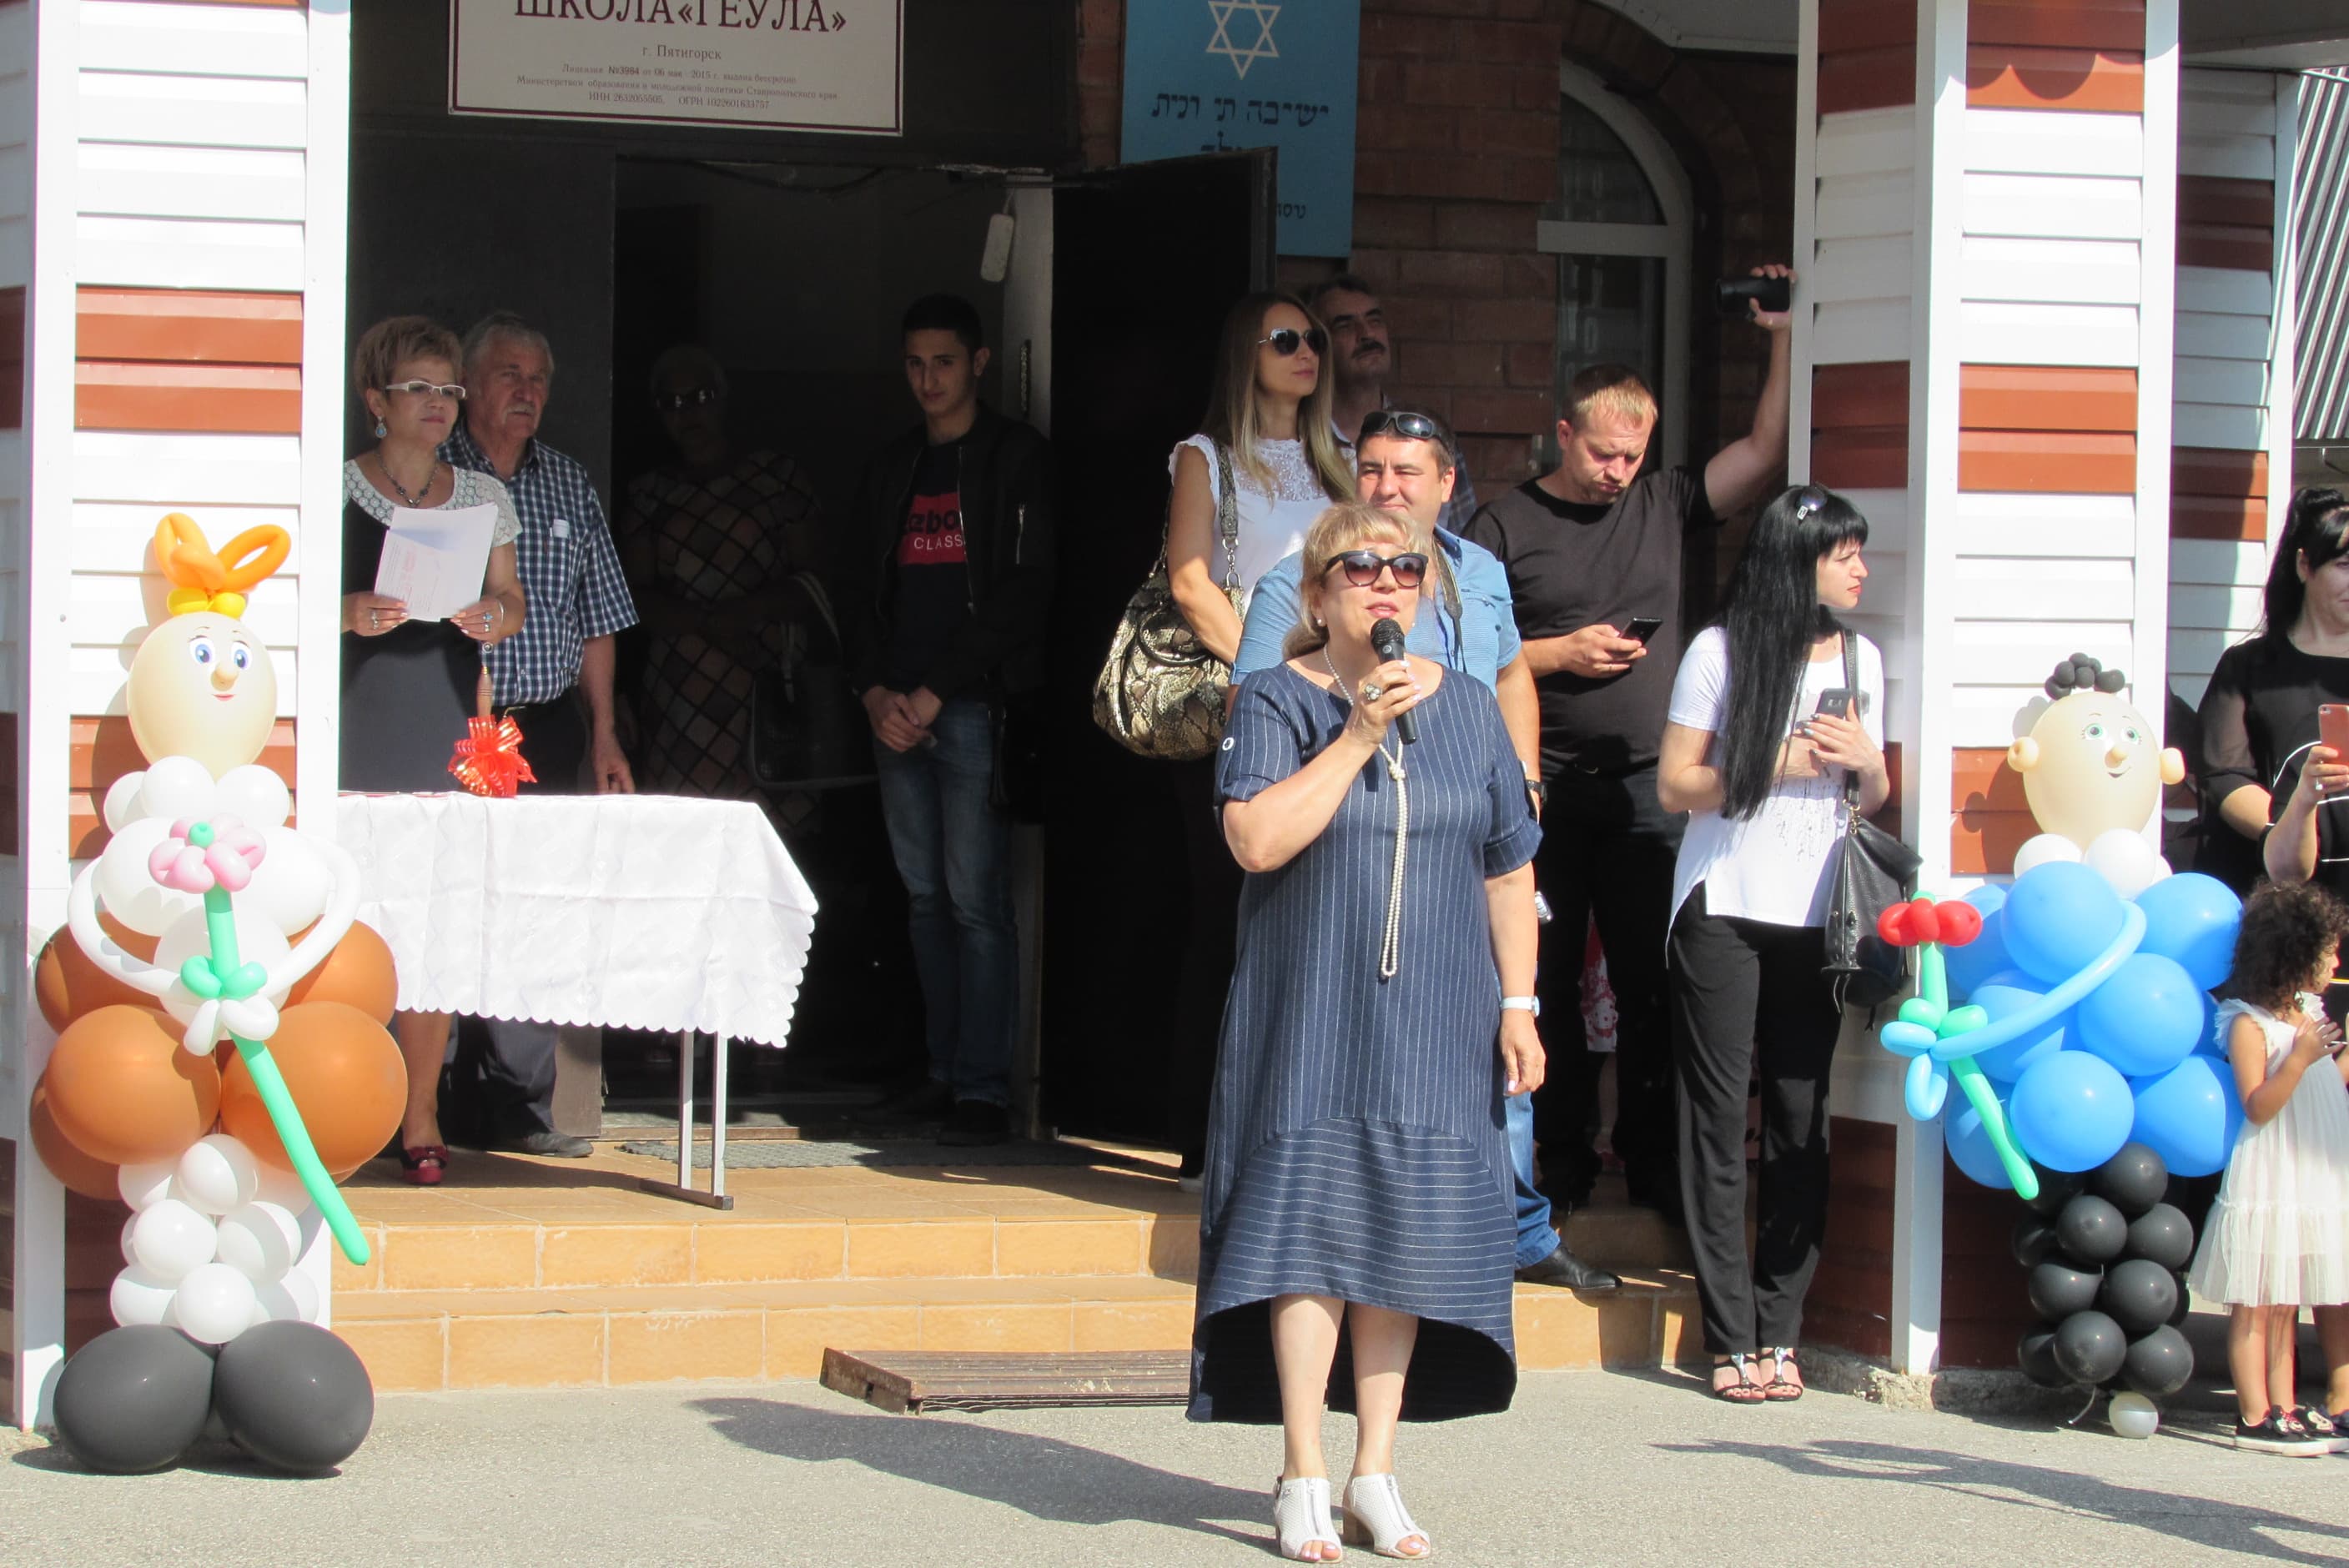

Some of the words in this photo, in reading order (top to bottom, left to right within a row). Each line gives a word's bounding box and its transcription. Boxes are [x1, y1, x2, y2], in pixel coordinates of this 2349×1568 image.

[656, 44, 722, 62] Пятигорск
[691, 69, 711, 79] 2015
[589, 91, 611, 102] ИНН
[678, 95, 703, 107] ОГРН
[747, 85, 816, 98] Ставропольского
[913, 534, 964, 551] CLASS
